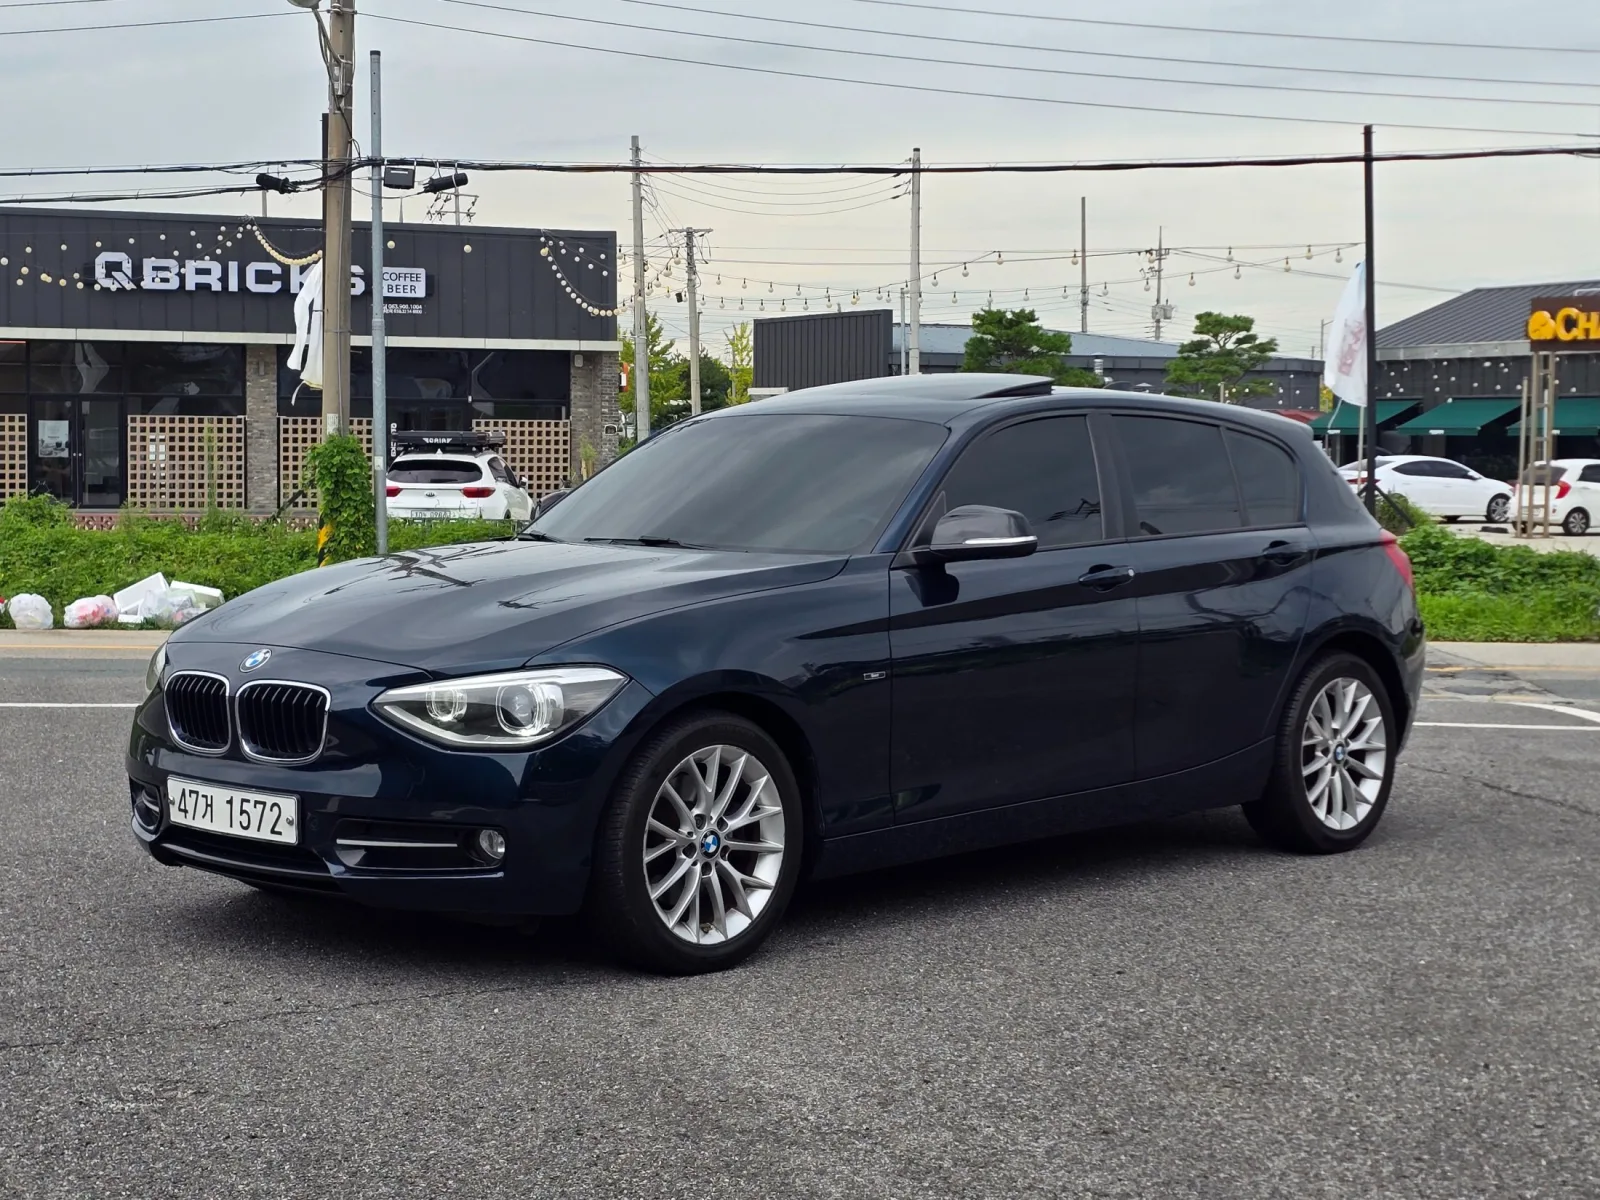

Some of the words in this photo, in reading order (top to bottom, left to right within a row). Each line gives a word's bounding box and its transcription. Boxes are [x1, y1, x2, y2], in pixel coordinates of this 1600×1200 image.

[383, 272, 421, 282] COFFEE
[387, 284, 417, 294] BEER
[1556, 307, 1600, 341] CH
[178, 788, 213, 823] 47거
[226, 796, 282, 835] 1572
